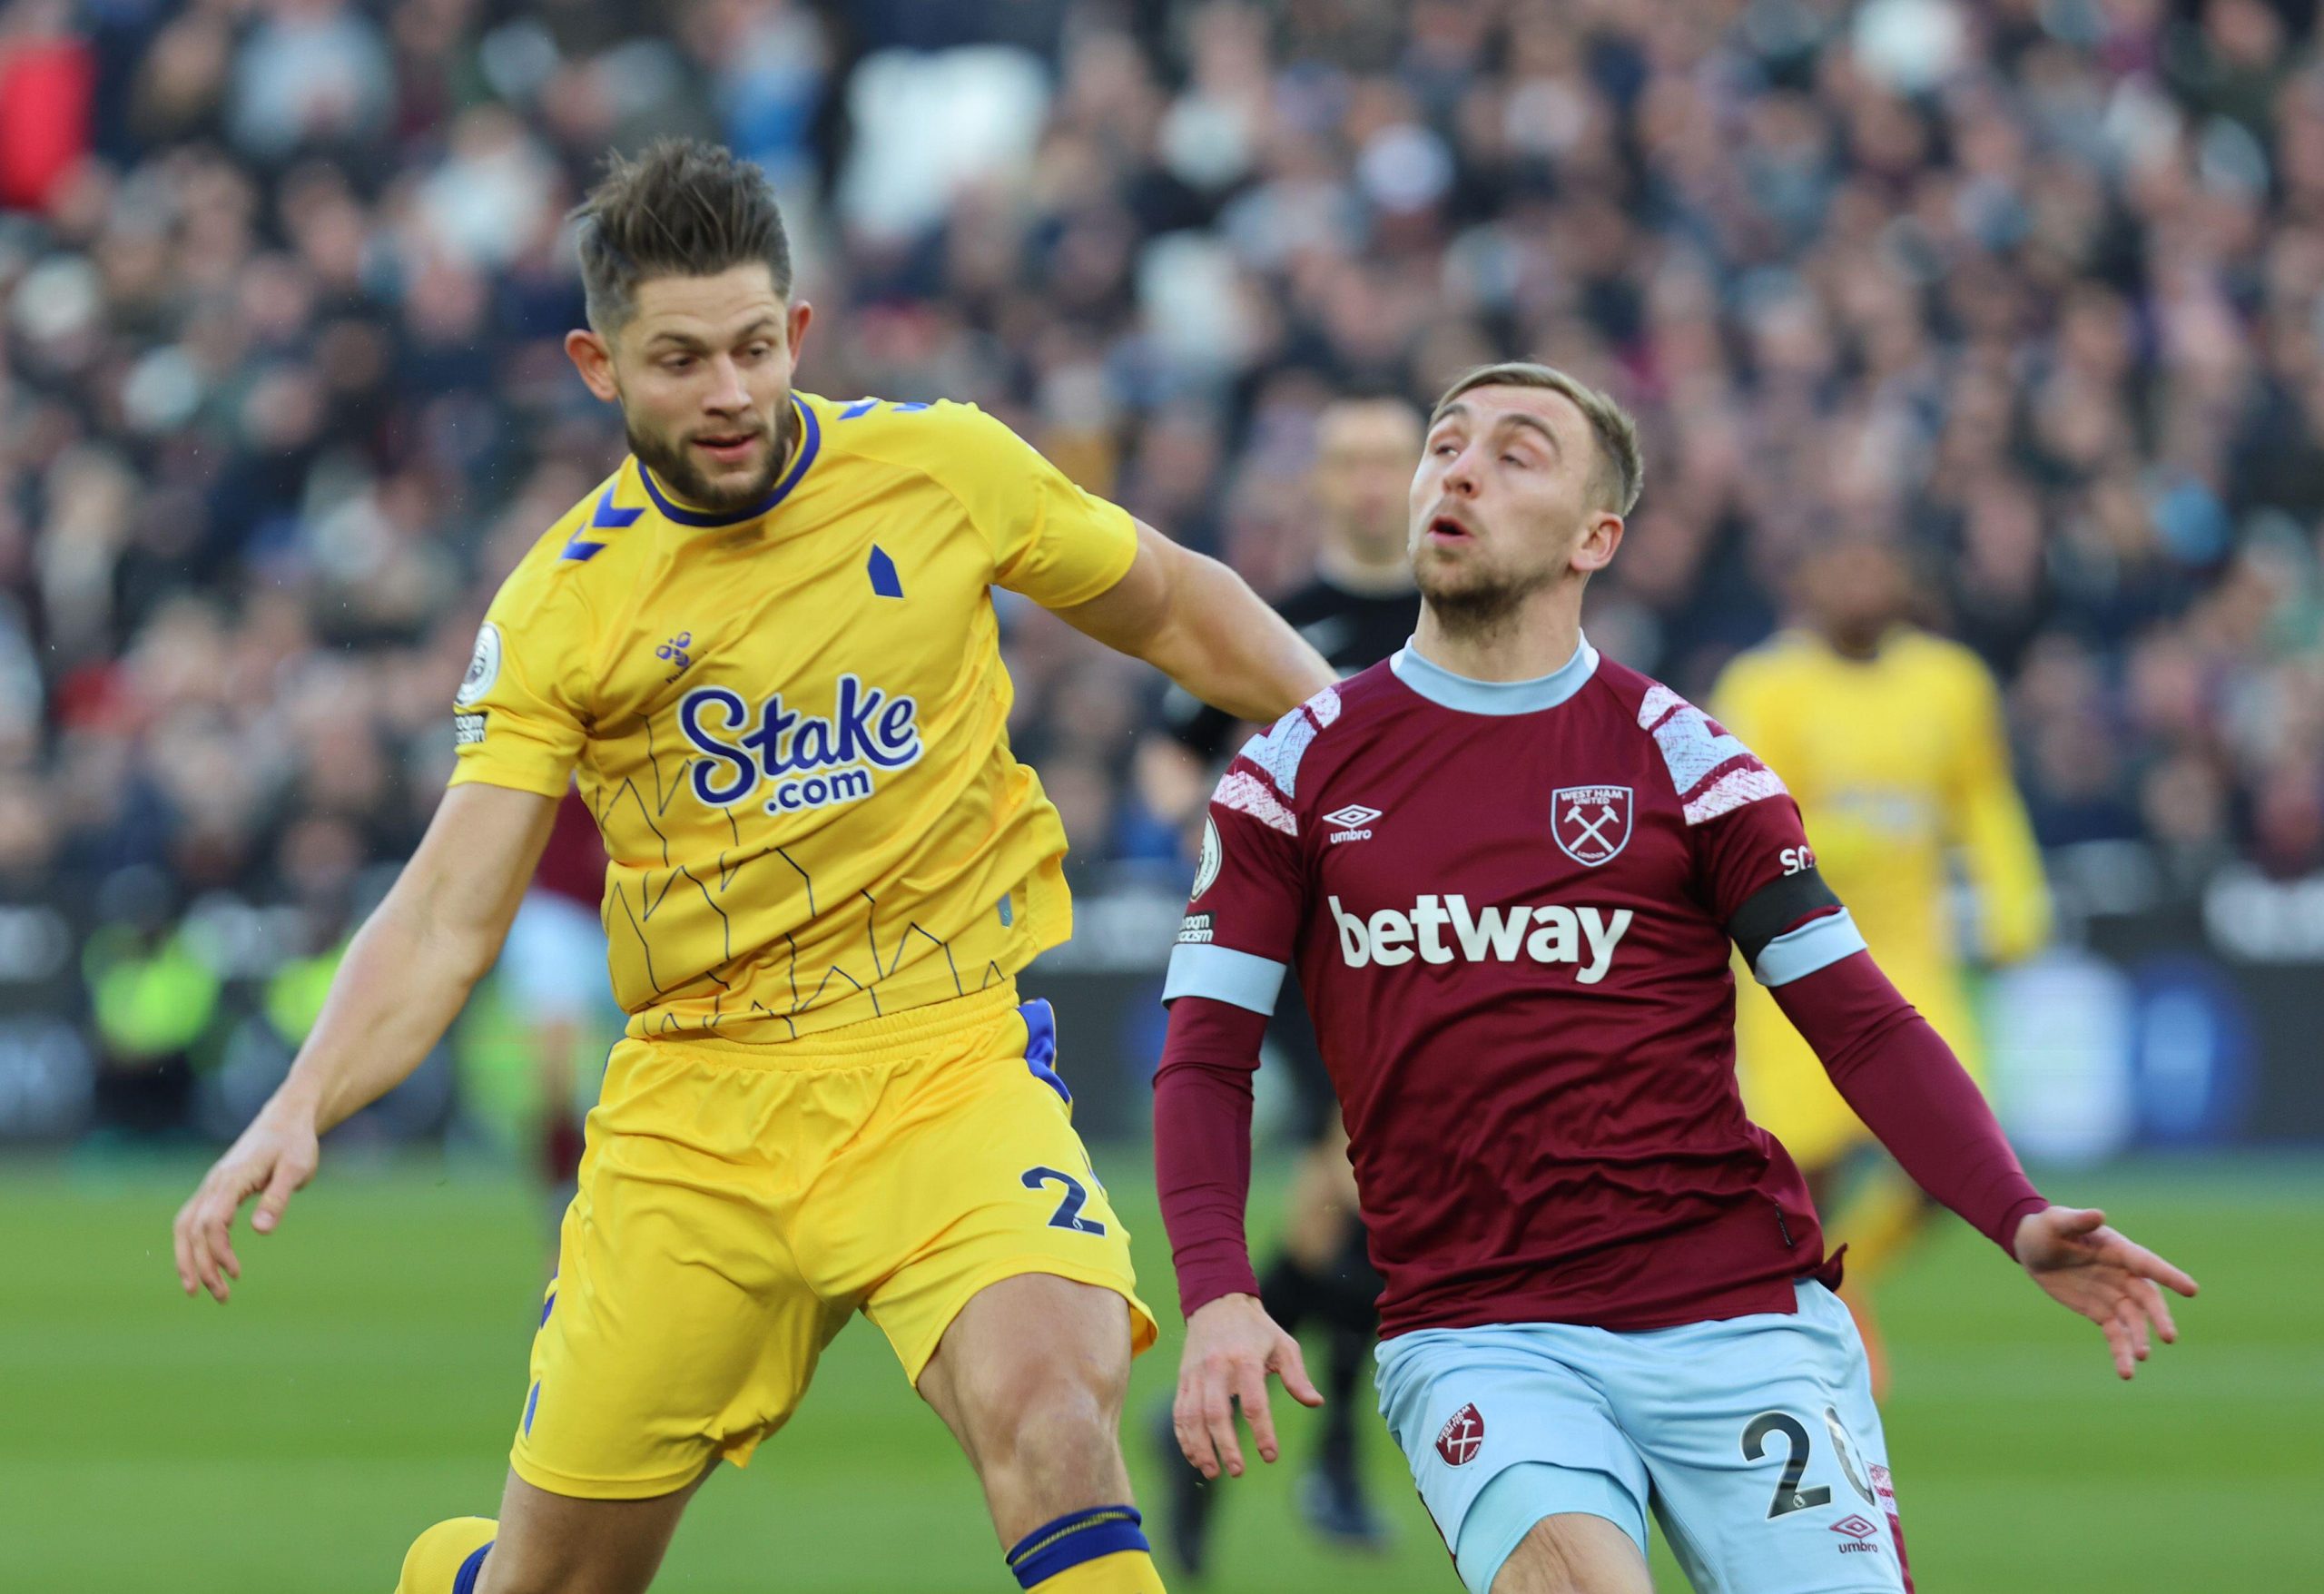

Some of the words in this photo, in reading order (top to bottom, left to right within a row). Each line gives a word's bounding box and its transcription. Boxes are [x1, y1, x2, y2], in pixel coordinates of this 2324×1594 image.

[679, 674, 923, 806] Stake
[766, 768, 871, 812] .com
[1561, 790, 1592, 802] WEST
[1593, 789, 1623, 800] HAM
[1573, 798, 1610, 806] UNITED
[1330, 828, 1373, 844] umbro
[1328, 894, 1634, 985] betway
[1020, 1166, 1106, 1237] 2
[1838, 1539, 1878, 1554] umbro
